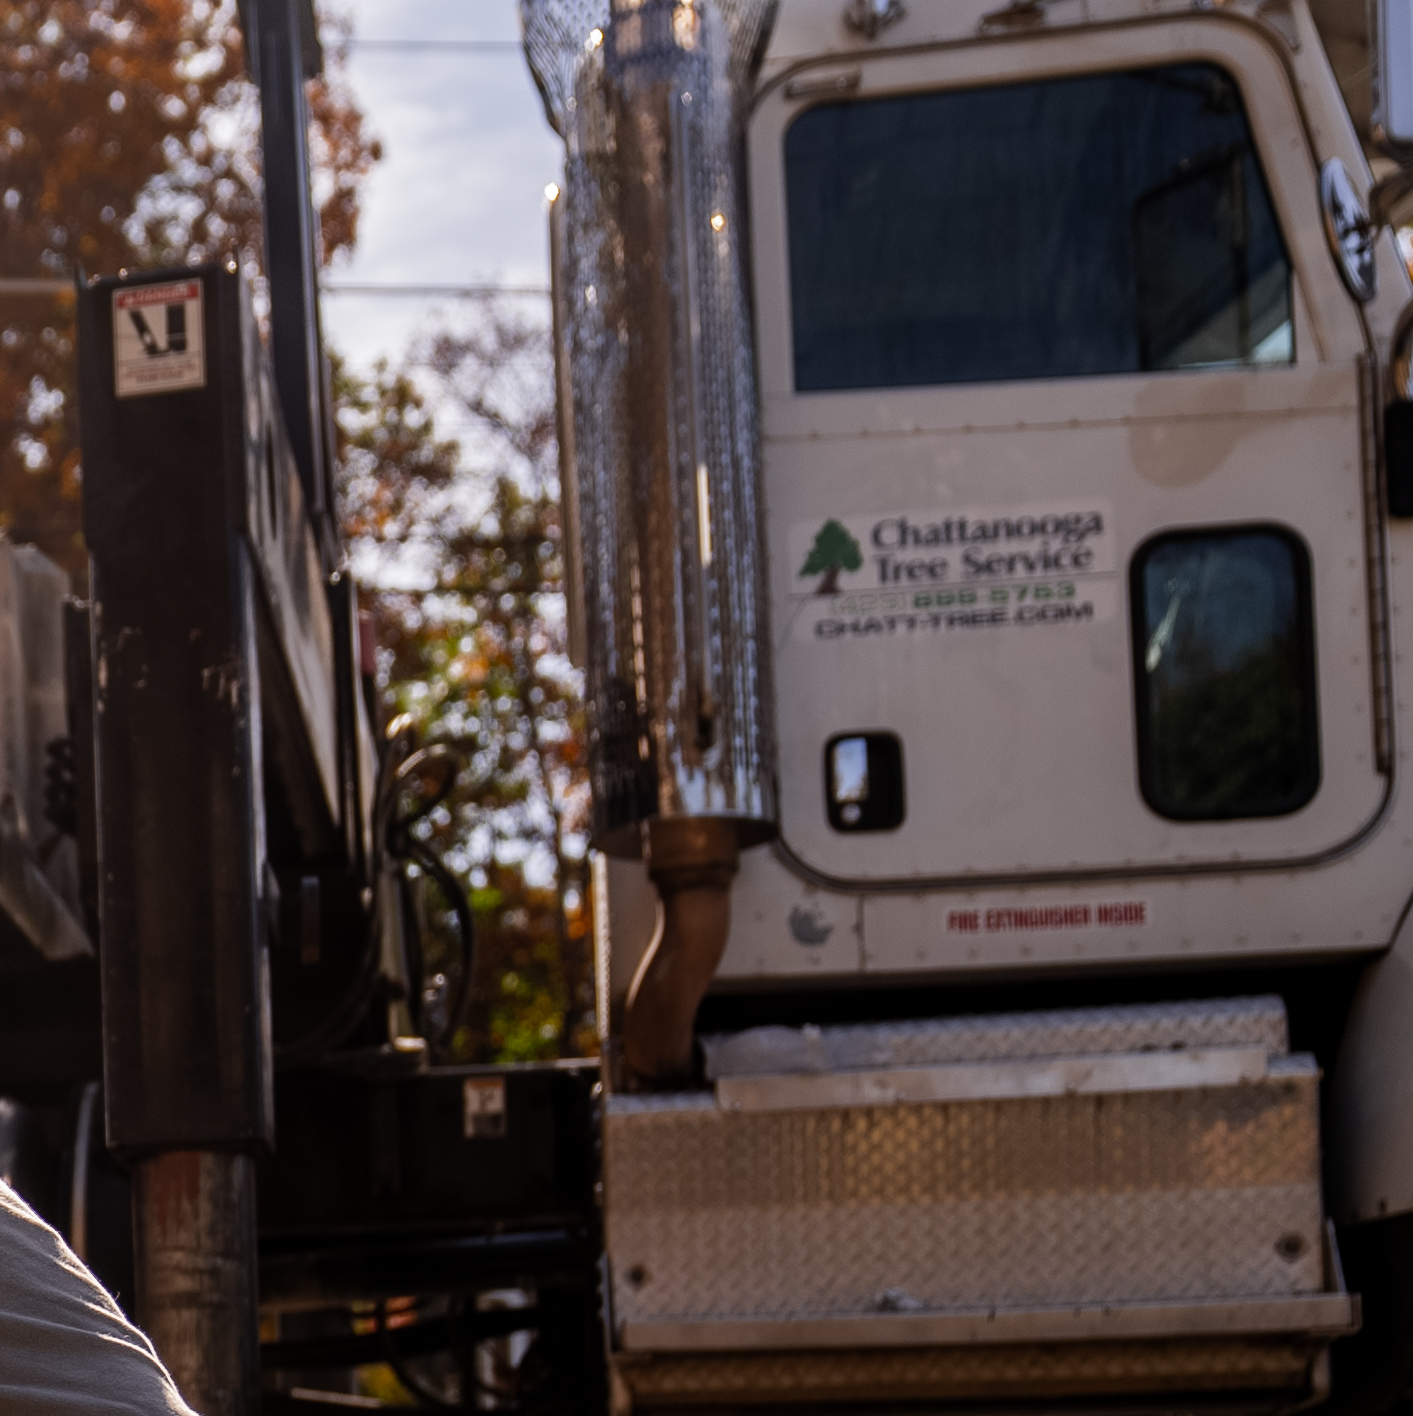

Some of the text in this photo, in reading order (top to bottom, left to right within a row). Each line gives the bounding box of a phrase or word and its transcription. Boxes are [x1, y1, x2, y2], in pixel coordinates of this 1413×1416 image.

[871, 512, 1104, 548] Chattanooga
[872, 541, 1094, 584] Tree Service
[815, 602, 1094, 639] CHATT-TREE.COM
[947, 903, 1145, 932] FIRE EXTINGUISHER INSIDE
